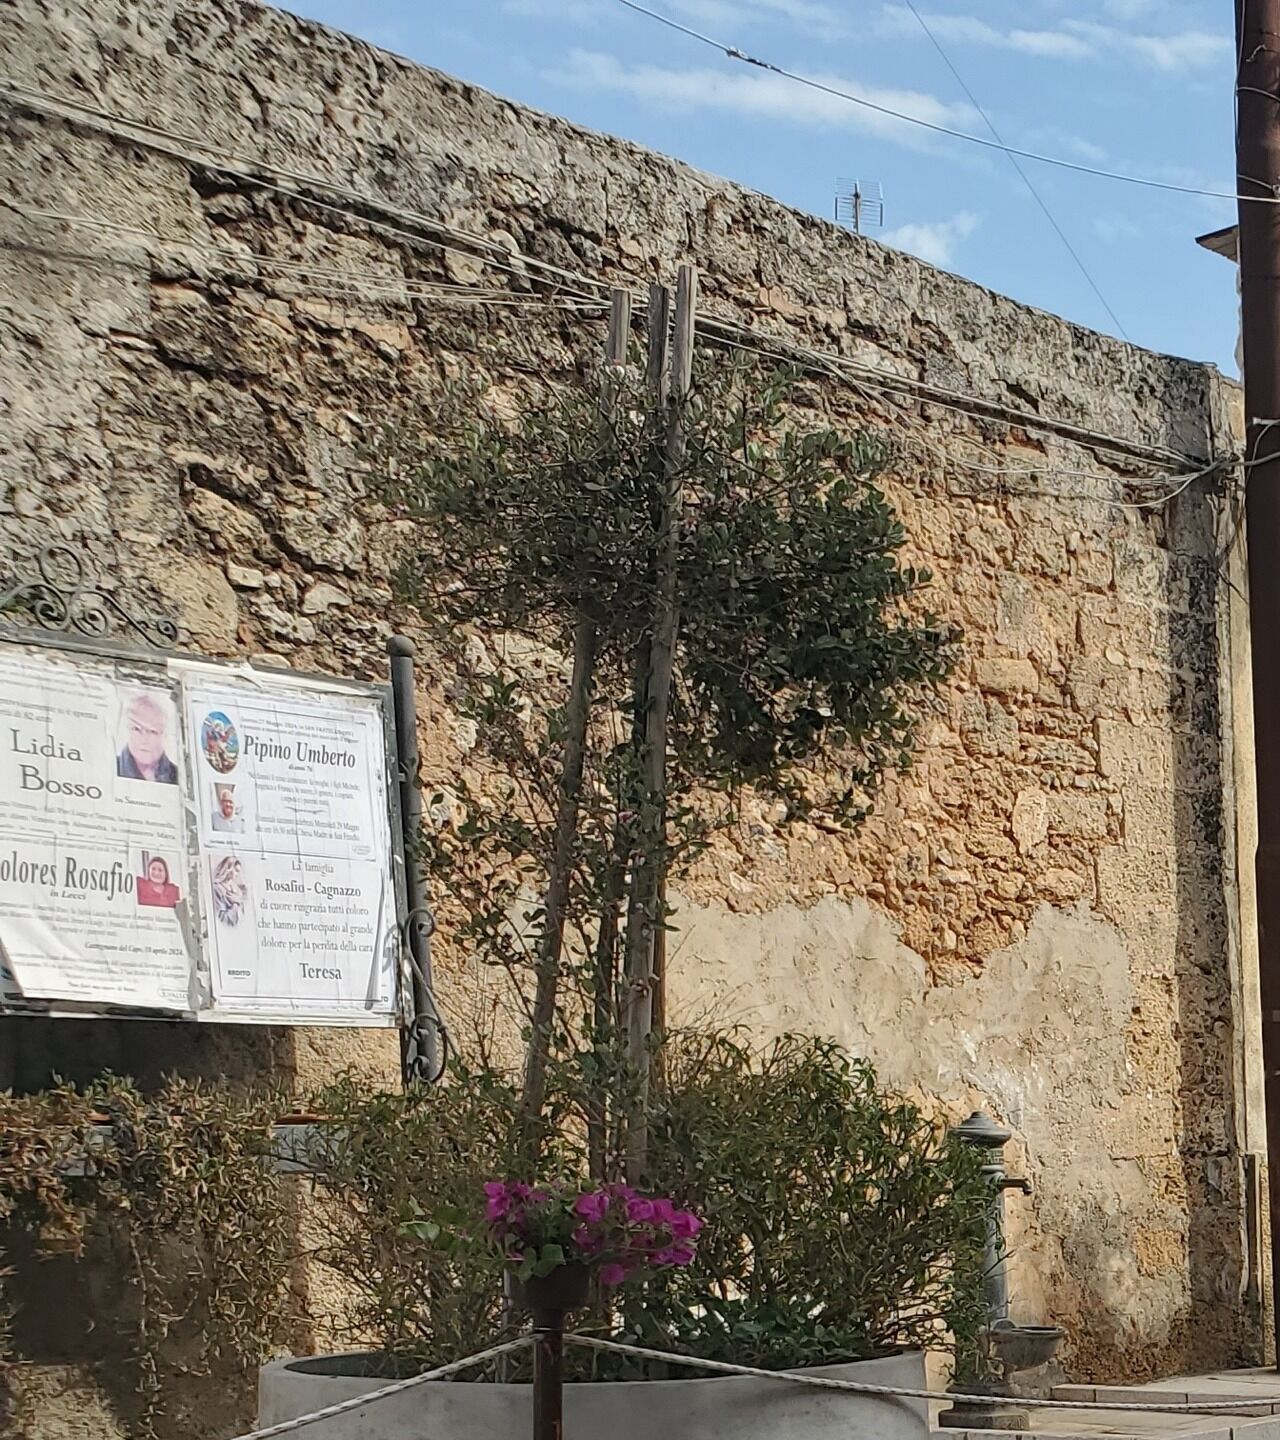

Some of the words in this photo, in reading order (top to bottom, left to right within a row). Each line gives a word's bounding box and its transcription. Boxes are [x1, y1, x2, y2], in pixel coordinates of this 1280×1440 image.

[9, 727, 84, 762] Lidia
[243, 734, 291, 762] Pipino
[296, 741, 356, 769] Umberto
[19, 764, 103, 800] Bosso
[64, 856, 134, 901] Rosafio
[291, 860, 301, 871] La
[305, 861, 334, 877] famiglia
[265, 878, 305, 893] Rosafio
[314, 881, 361, 900] Cagnazzo
[260, 899, 268, 910] di
[270, 902, 291, 911] cuore
[294, 902, 327, 917] ringrazia
[328, 904, 345, 914] tutti
[346, 904, 369, 915] coloro
[257, 917, 271, 929] che
[273, 918, 297, 930] hanno
[299, 921, 340, 936] partecipato
[350, 922, 374, 938] grande
[261, 936, 287, 948] dolore
[288, 941, 302, 953] per
[312, 940, 339, 954] perdita
[340, 940, 357, 952] della
[299, 962, 342, 980] Teresa
